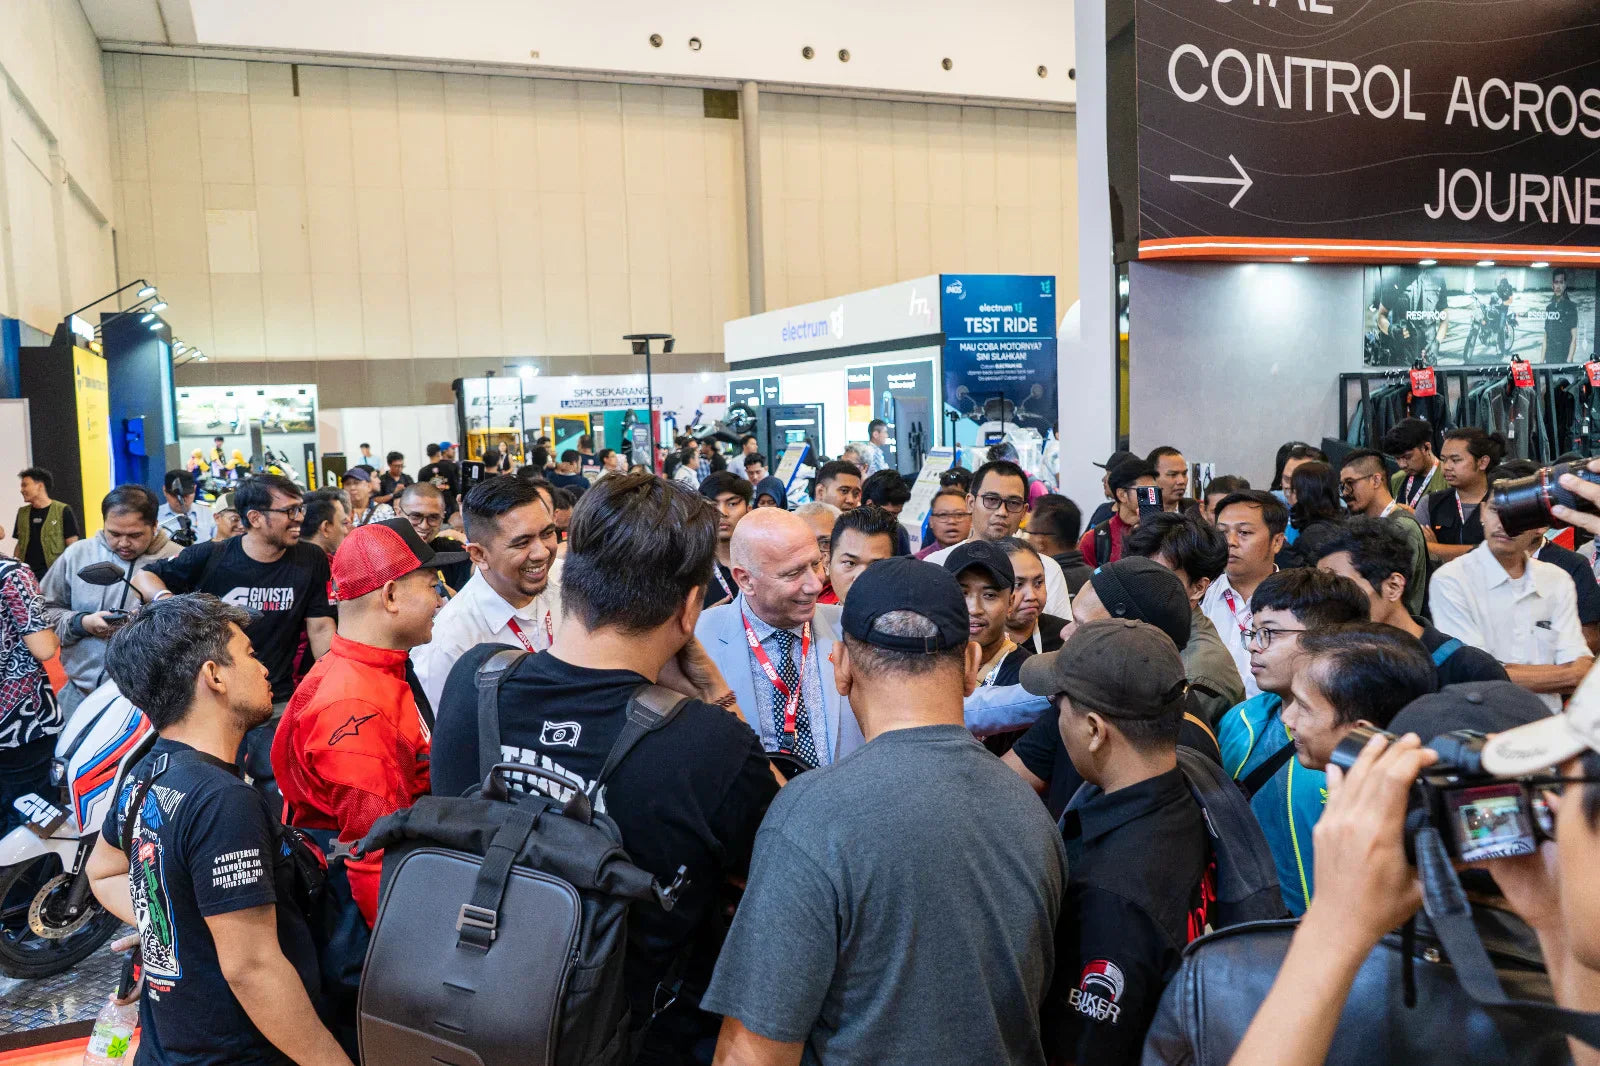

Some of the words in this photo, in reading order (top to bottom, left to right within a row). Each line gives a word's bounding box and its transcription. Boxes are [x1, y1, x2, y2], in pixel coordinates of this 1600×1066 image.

[1168, 43, 1426, 121] CONTROL
[1424, 168, 1600, 225] JOURNE
[979, 303, 1013, 312] electrum
[1527, 311, 1561, 321] ESSENZO
[782, 319, 829, 342] electrum
[964, 317, 1000, 333] TEST
[1003, 317, 1038, 333] RIDE
[960, 342, 977, 351] MAU
[977, 342, 999, 351] COBA
[574, 389, 594, 398] SPK
[595, 387, 650, 397] SEKARANG
[249, 587, 294, 602] GIVISTA
[13, 792, 63, 829] GIVI
[1069, 988, 1121, 1024] BIKER
